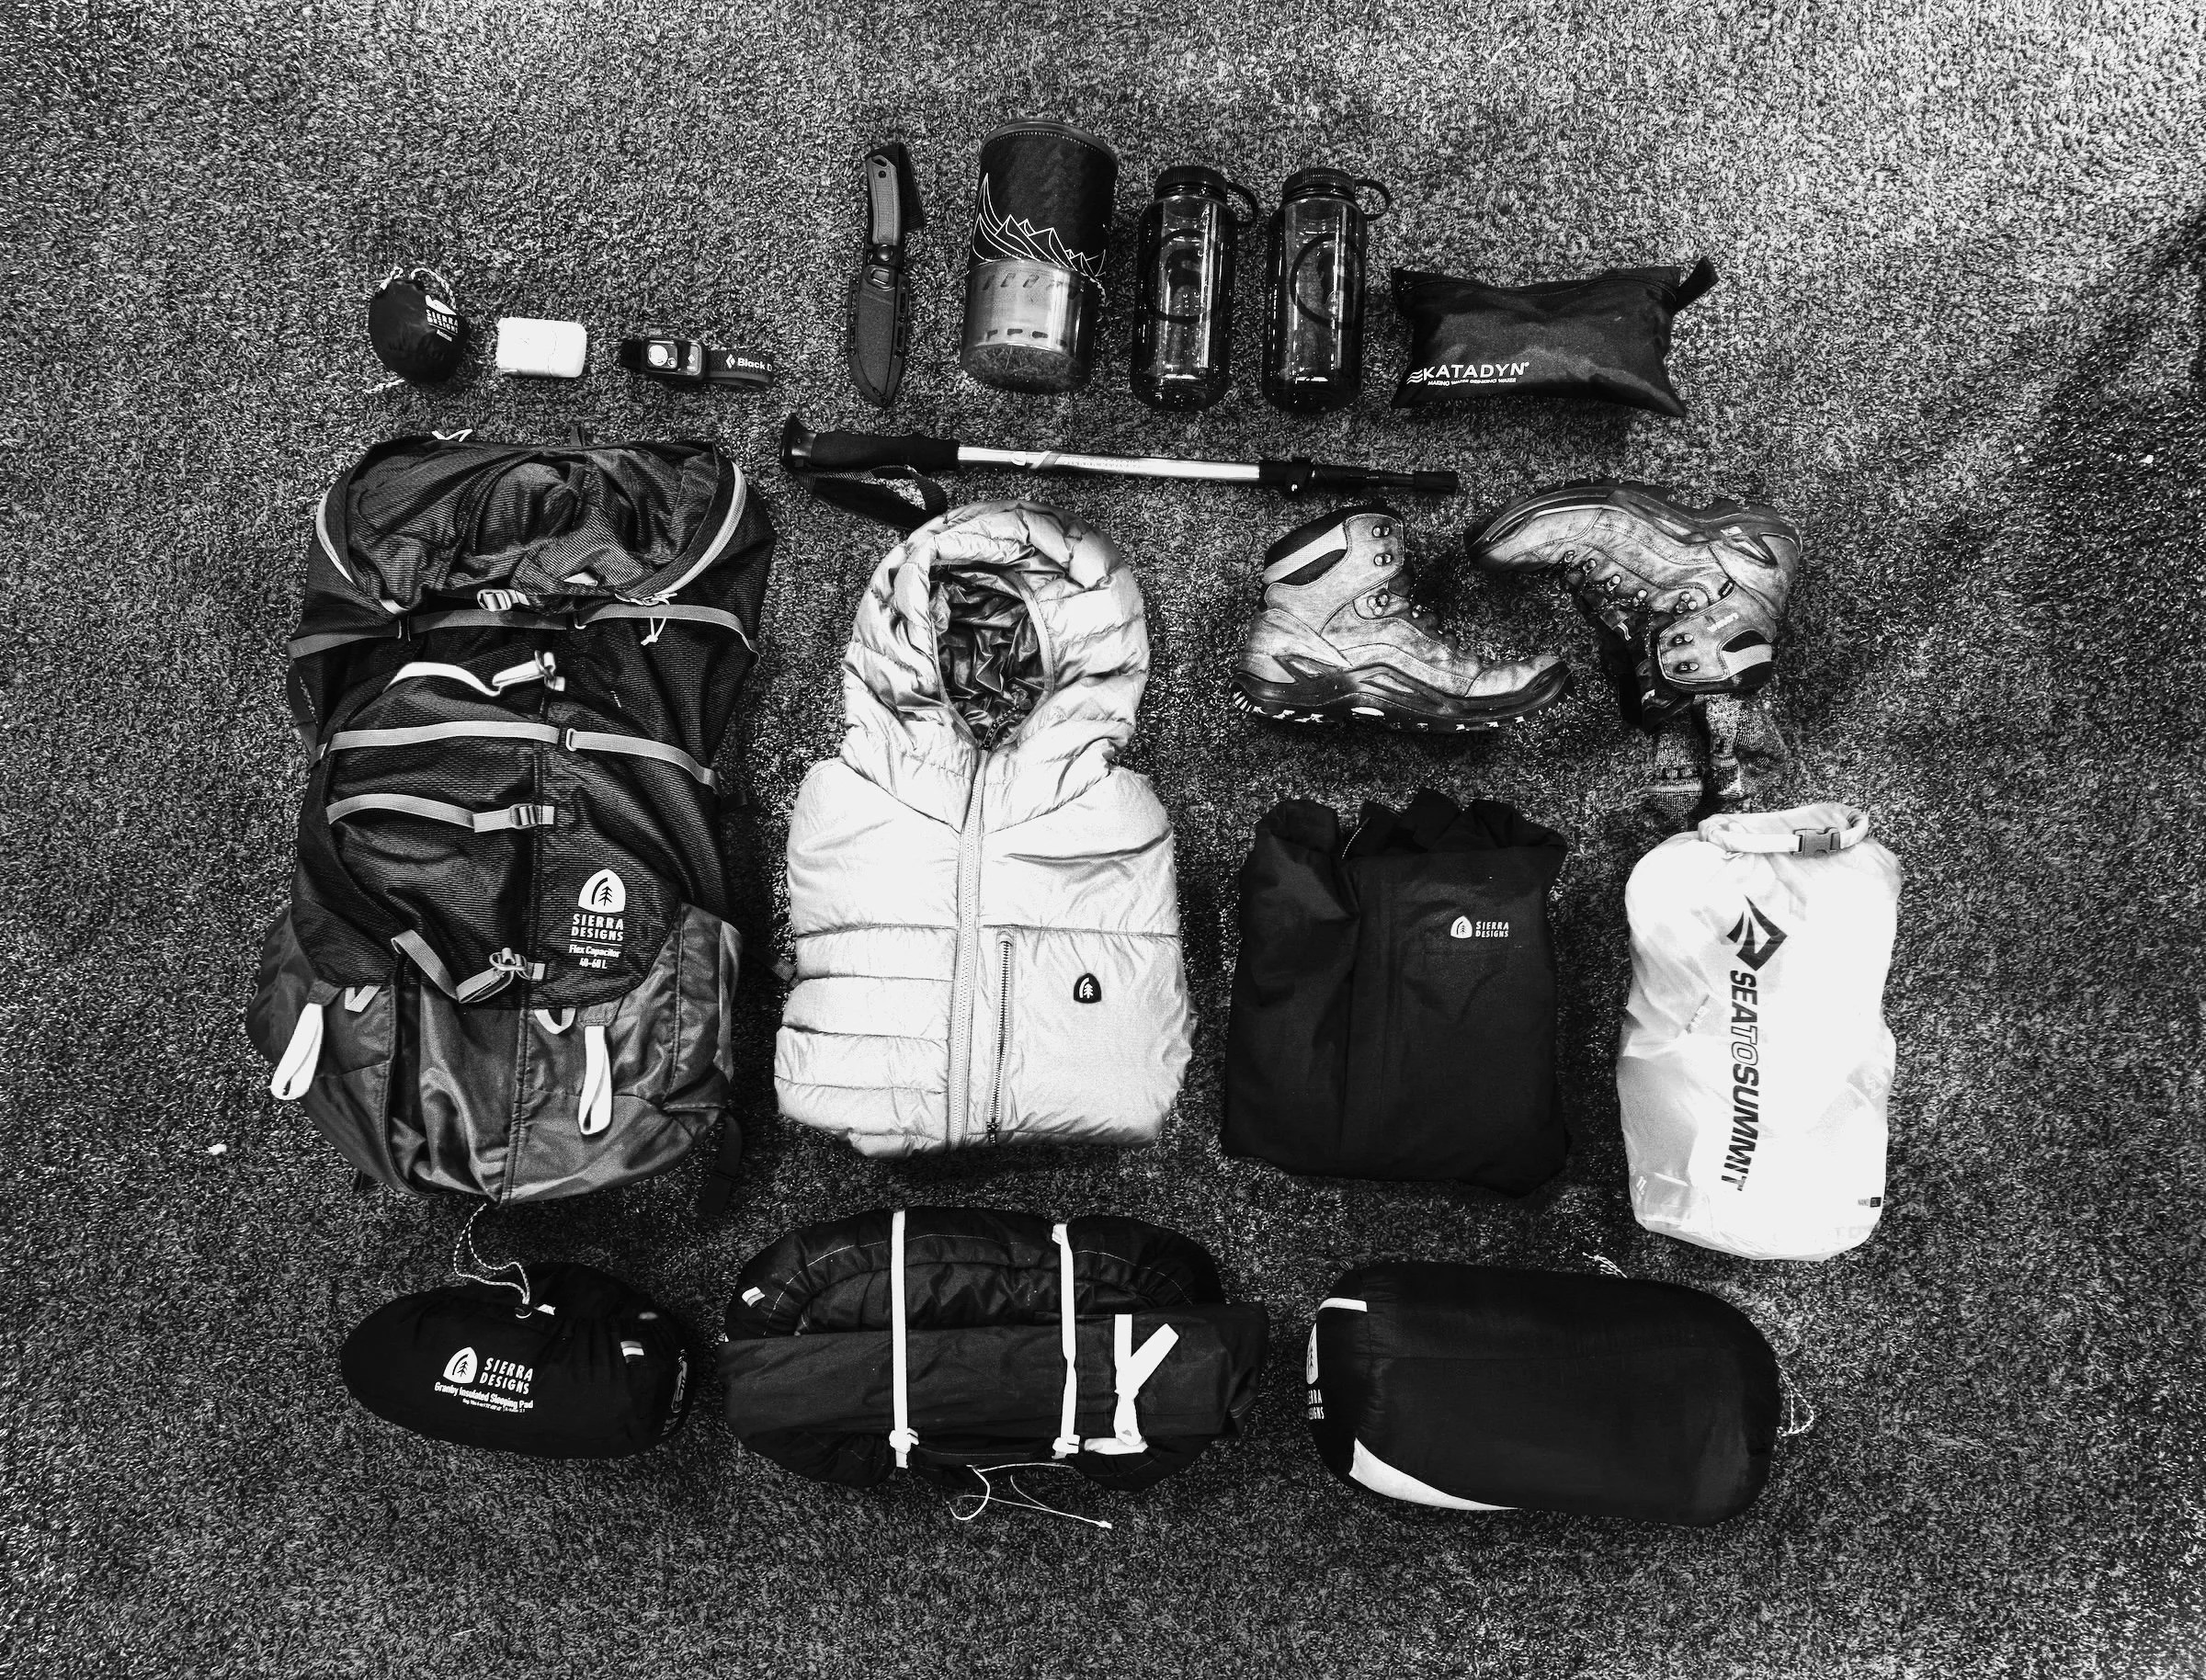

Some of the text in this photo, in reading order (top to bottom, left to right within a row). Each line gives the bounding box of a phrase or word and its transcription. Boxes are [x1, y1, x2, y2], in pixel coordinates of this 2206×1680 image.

[426, 309, 459, 327] SIERRA
[737, 357, 766, 370] Black
[572, 913, 624, 931] SIERRA
[1475, 921, 1509, 931] SIERRA
[571, 925, 624, 942] DESIGNS
[1475, 929, 1509, 938] DESIGNS
[569, 944, 621, 959] Flex Capacitor
[601, 959, 608, 970] L
[483, 1356, 534, 1382] SIERRA
[479, 1371, 530, 1395] DESIGNS
[434, 1381, 460, 1397] Granby
[459, 1386, 490, 1402] Insulated
[490, 1392, 518, 1410] Sleeping
[518, 1400, 534, 1409] Pad
